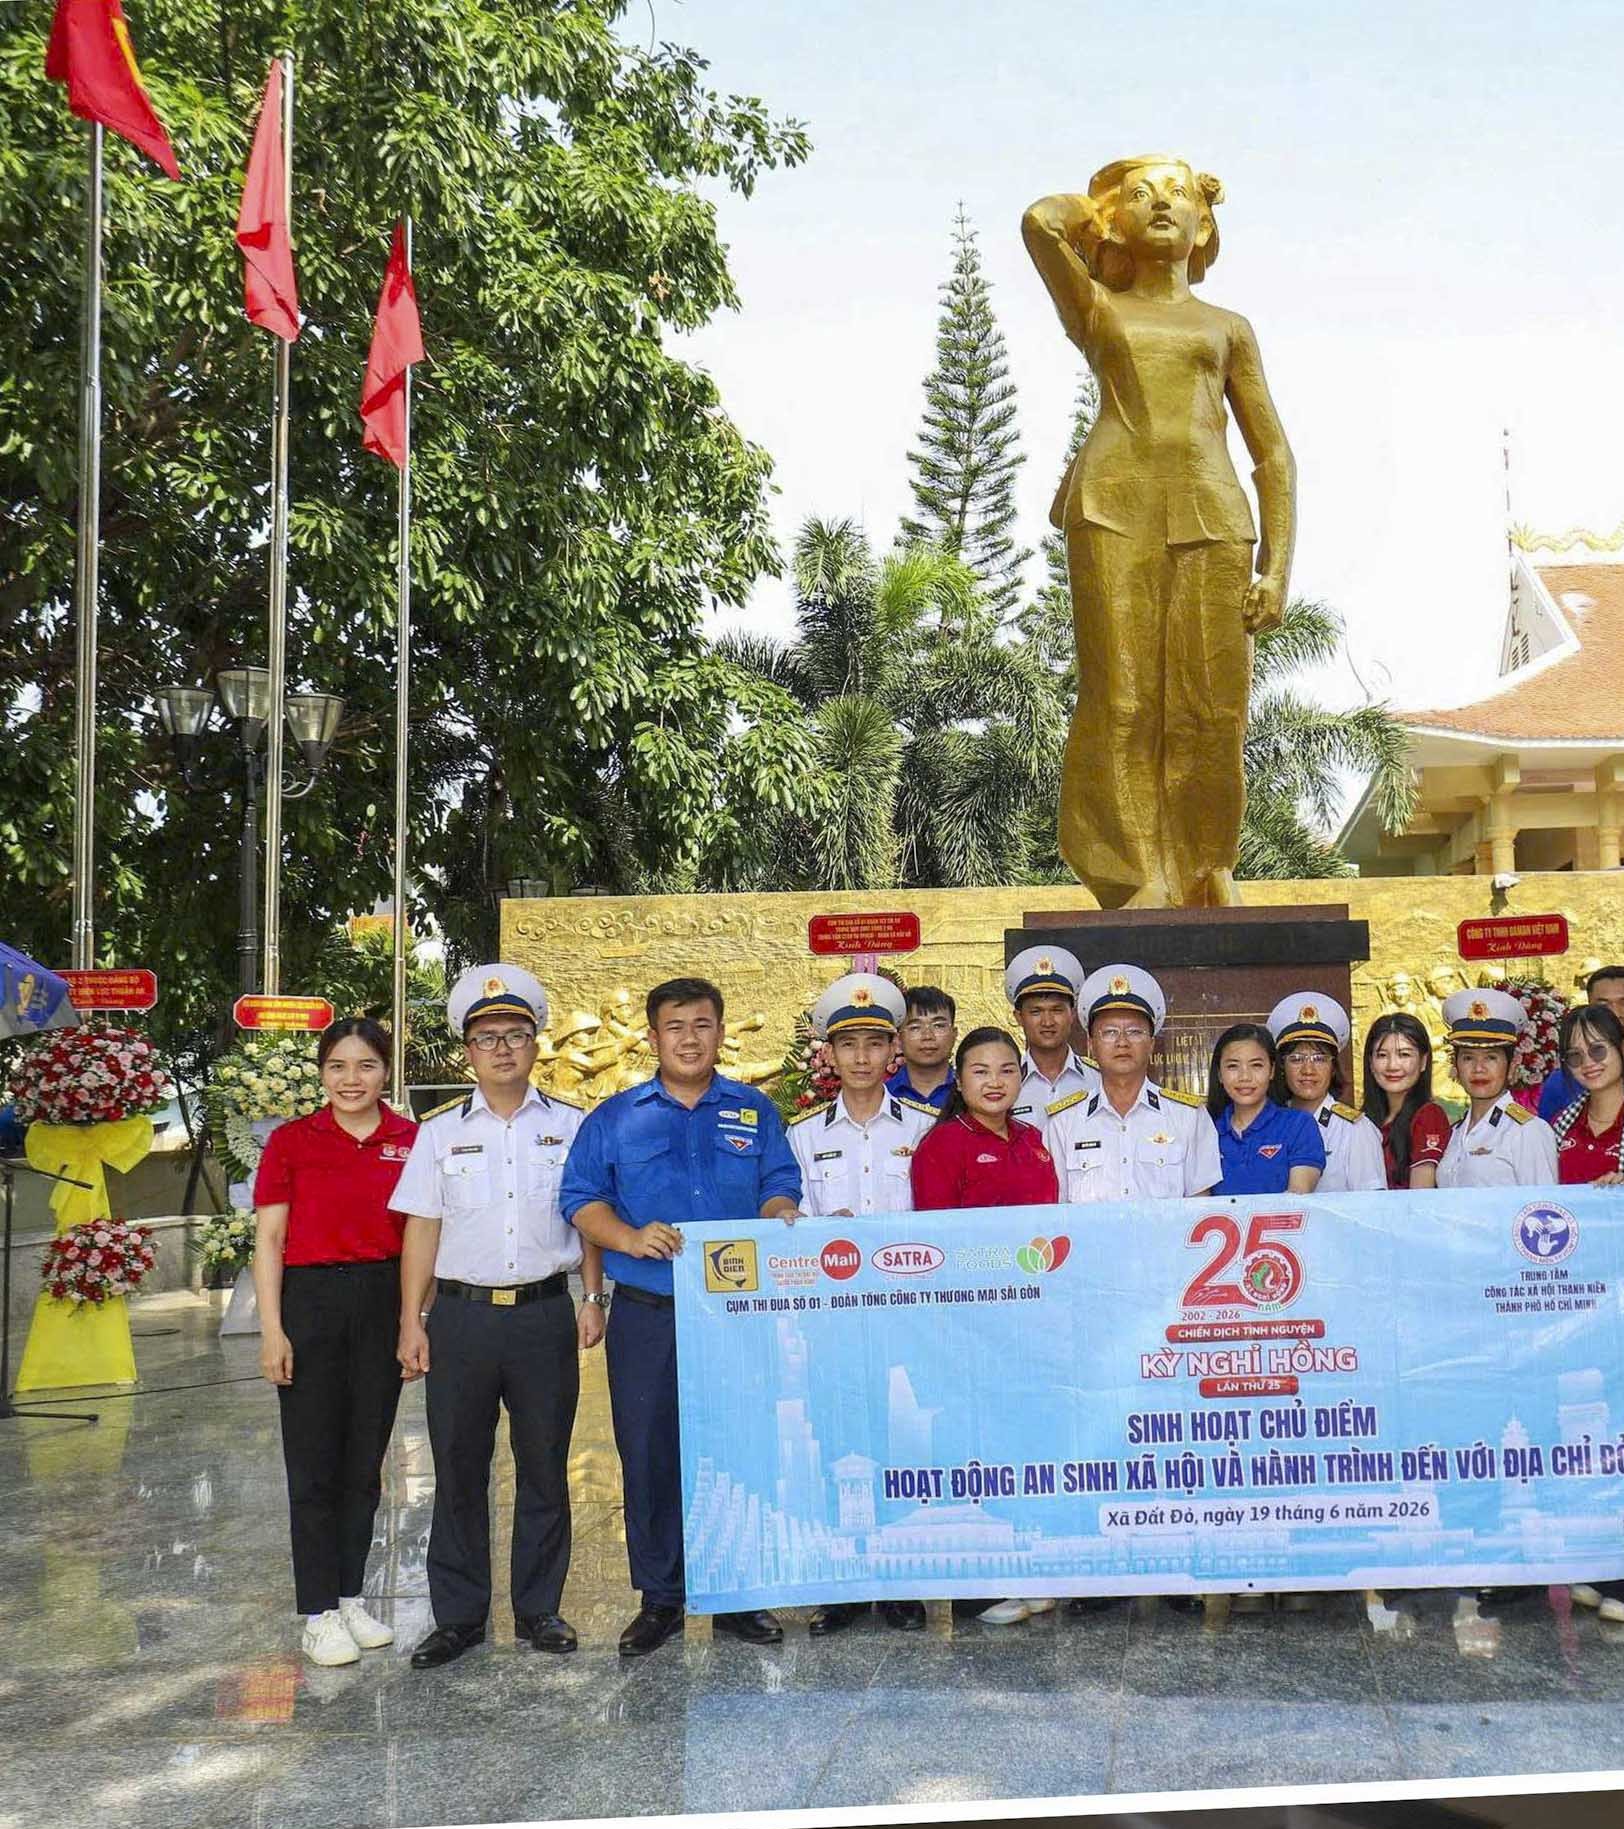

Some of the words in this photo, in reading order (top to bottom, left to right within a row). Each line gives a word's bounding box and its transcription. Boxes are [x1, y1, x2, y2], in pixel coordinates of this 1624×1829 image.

[767, 1255, 820, 1270] Centre
[823, 1252, 859, 1269] Mall
[883, 1249, 933, 1269] SATRA
[1179, 1212, 1306, 1309] 25
[1519, 1270, 1548, 1282] TRUNG
[1549, 1268, 1569, 1281] TÂM
[726, 1300, 750, 1314] CỤM
[752, 1298, 767, 1313] THI
[769, 1297, 790, 1312] ĐUA
[830, 1294, 859, 1309] ĐOÀN
[861, 1291, 887, 1308] TỔNG
[889, 1289, 917, 1306] CÔNG
[920, 1291, 932, 1305] TY
[934, 1288, 975, 1304] THƯƠNG
[977, 1287, 998, 1304] MẠI
[1000, 1284, 1018, 1301] SÀI
[1020, 1283, 1041, 1300] GÒN
[1484, 1284, 1504, 1298] CÔNG
[1557, 1283, 1583, 1296] THANH
[1495, 1299, 1523, 1313] THÀNH
[1524, 1298, 1542, 1312] PHỐ
[1558, 1297, 1572, 1311] CHÍ
[1574, 1297, 1598, 1310] MINH
[1181, 1310, 1206, 1322] 2002
[1216, 1309, 1241, 1321] 2026
[1177, 1325, 1212, 1339] CHIẾN
[1214, 1326, 1240, 1339] DỊCH
[1243, 1323, 1270, 1337] TÌNH
[1271, 1322, 1316, 1338] NGUYỆN
[1141, 1345, 1185, 1378] KỲ
[1187, 1342, 1262, 1377] NGHỈ
[1269, 1339, 1358, 1375] HỒNG
[1266, 1379, 1281, 1391] 25
[1127, 1412, 1183, 1444] SINH
[1190, 1409, 1252, 1447] HOẠT
[1259, 1399, 1308, 1439] CHỦ
[1314, 1398, 1377, 1438] ĐIỂM
[884, 1468, 944, 1504] HOẠT
[951, 1460, 1016, 1504] ĐỘNG
[1023, 1463, 1056, 1495] AN
[1062, 1461, 1119, 1493] SINH
[1126, 1453, 1158, 1491] XÃ
[1164, 1451, 1206, 1496] HỘI
[1211, 1450, 1245, 1488] VÀ
[1252, 1447, 1316, 1487] HÀNH
[1323, 1445, 1394, 1483] TRÌNH
[1401, 1442, 1448, 1483] ĐẾN
[1454, 1439, 1496, 1481] VỚI
[1503, 1444, 1543, 1485] ĐỊA
[1551, 1434, 1593, 1477] CHỈ
[1107, 1510, 1131, 1527] Xã
[1134, 1508, 1165, 1526] Đất
[1170, 1508, 1199, 1528] Đỏ,
[1203, 1508, 1245, 1531] ngày
[1251, 1506, 1271, 1522] 19
[1275, 1503, 1325, 1524] tháng
[1329, 1505, 1341, 1519] 6
[1345, 1502, 1384, 1519] năm
[1388, 1501, 1430, 1518] 2026
